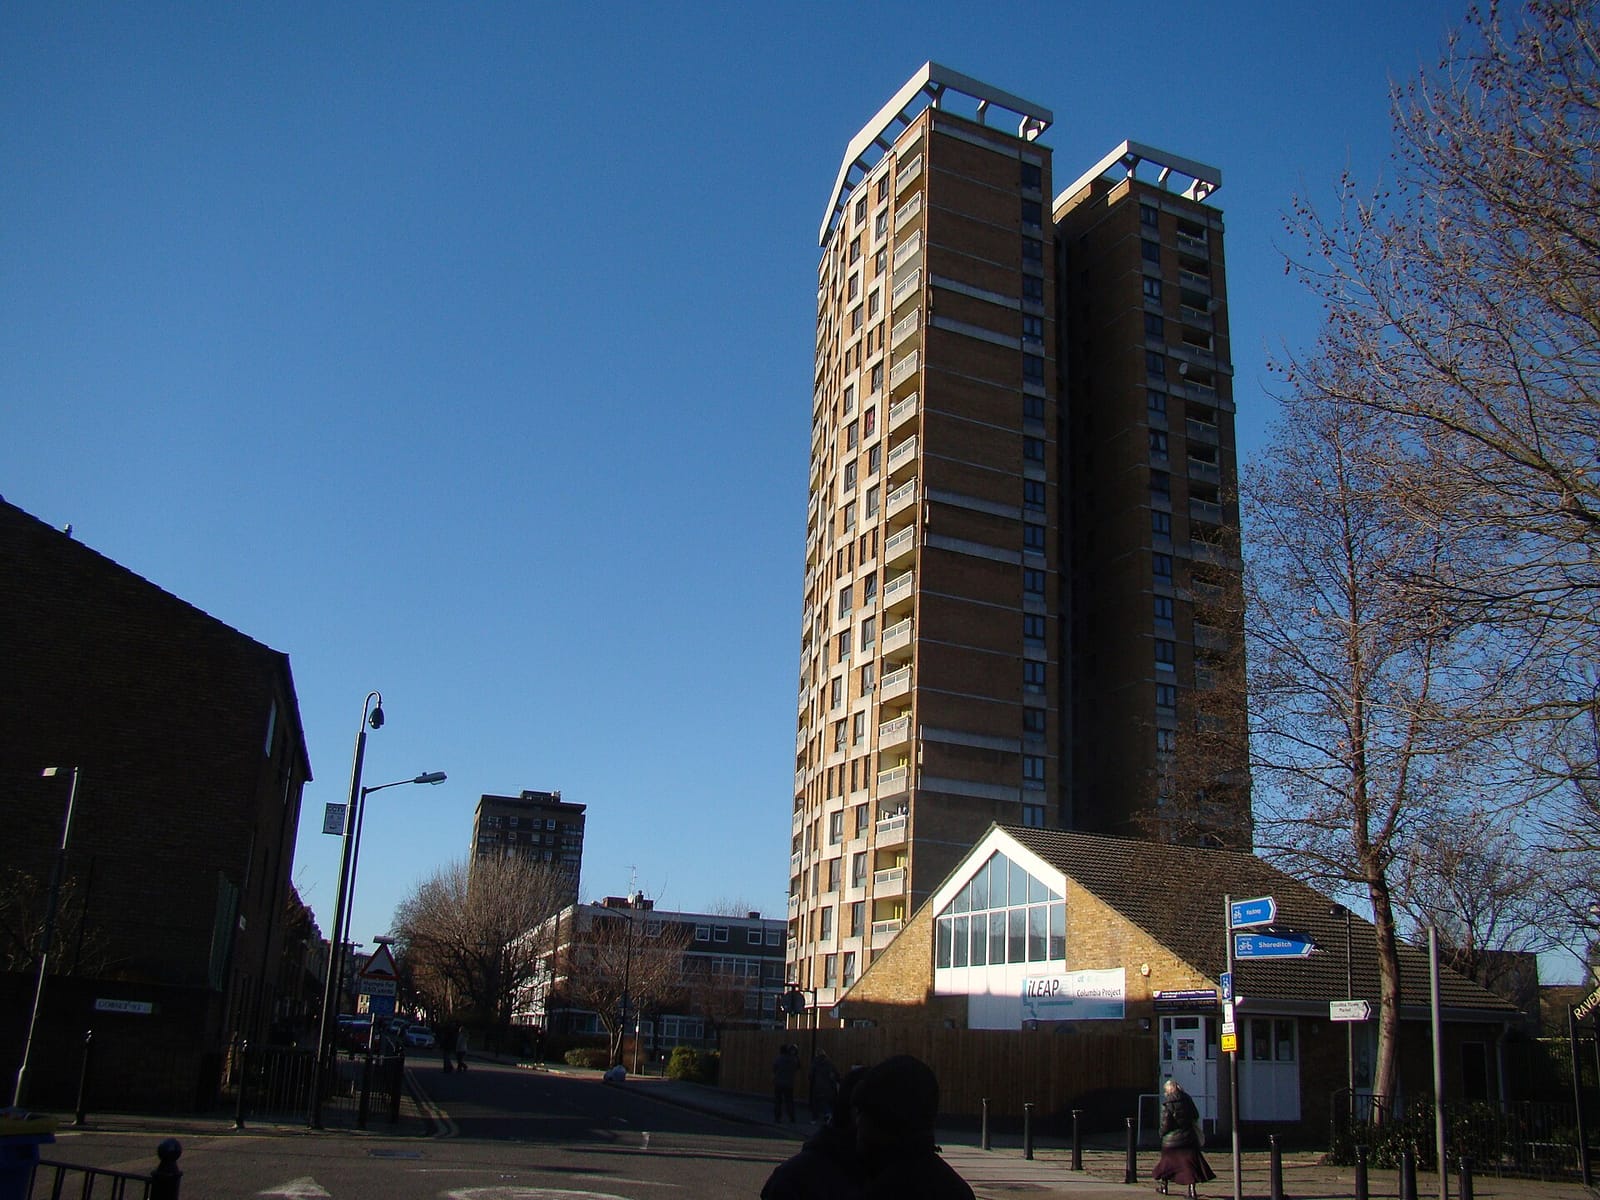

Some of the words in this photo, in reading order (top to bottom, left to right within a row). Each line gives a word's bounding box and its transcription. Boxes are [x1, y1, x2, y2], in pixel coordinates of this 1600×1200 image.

[1027, 979, 1060, 998] iLEAP
[1076, 987, 1101, 997] Columbia
[1102, 988, 1121, 998] Project
